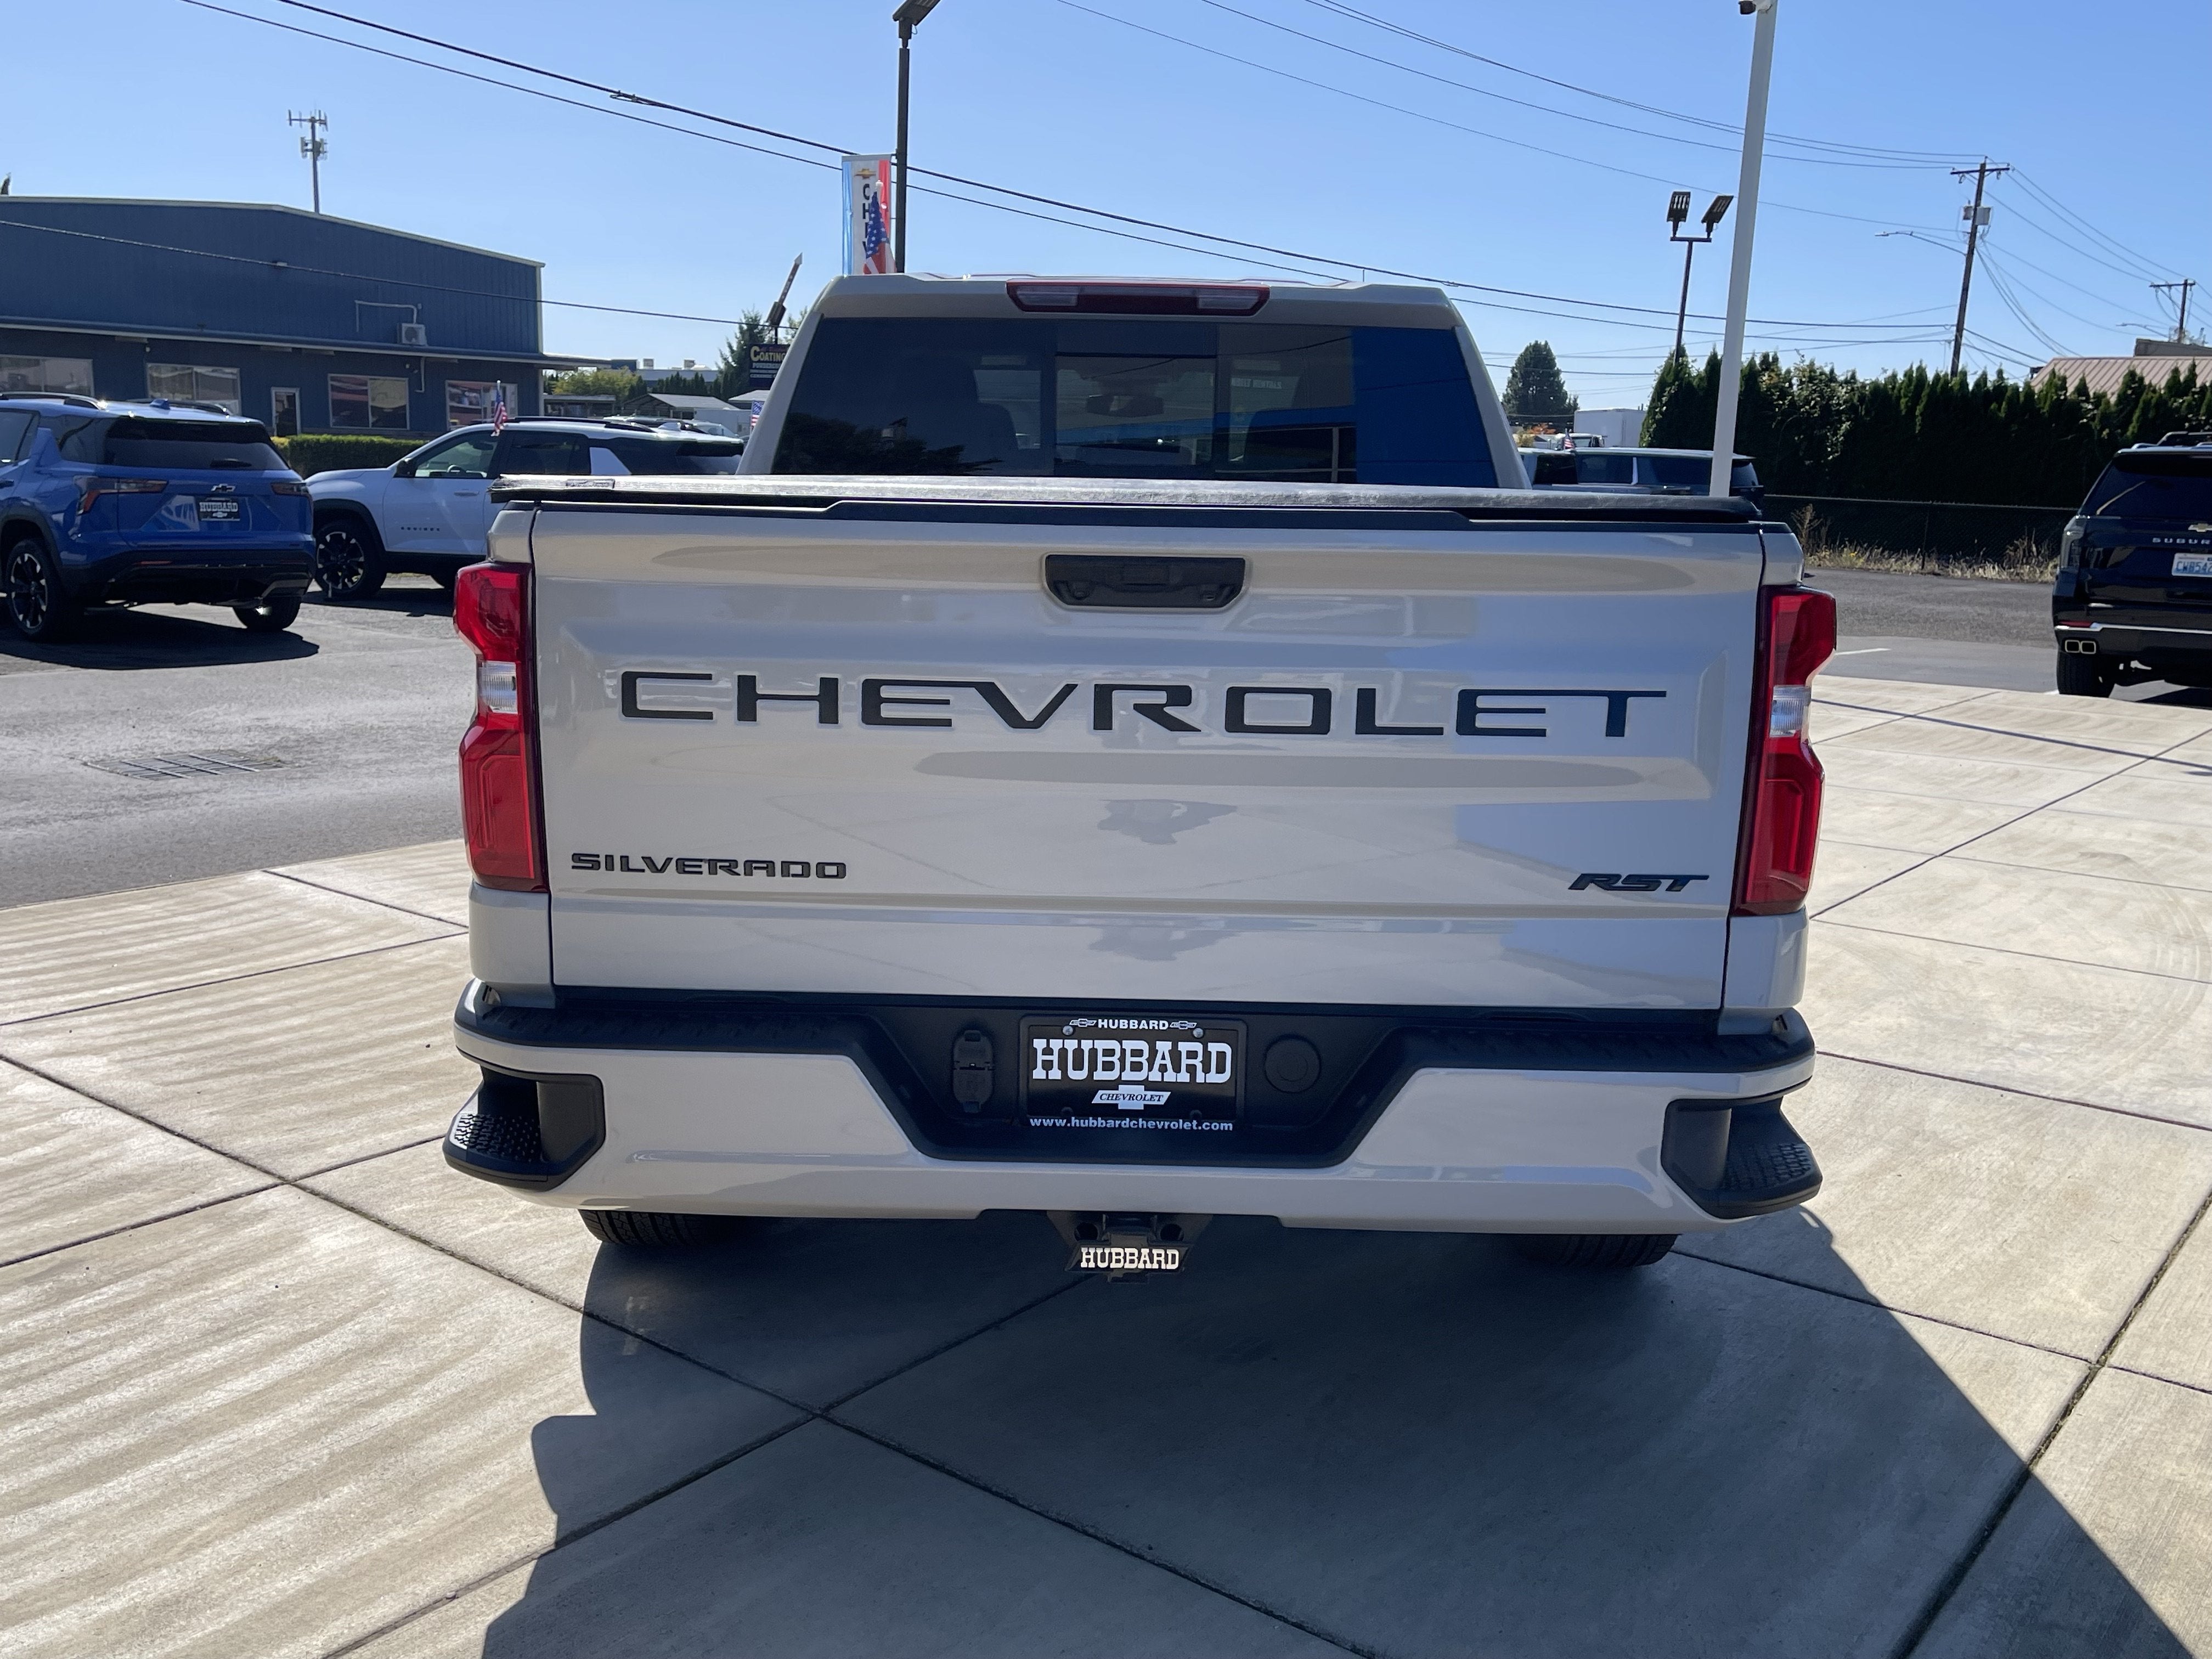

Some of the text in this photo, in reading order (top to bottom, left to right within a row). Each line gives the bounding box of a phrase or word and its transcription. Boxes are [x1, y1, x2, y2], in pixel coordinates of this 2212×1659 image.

[621, 671, 1667, 737] CHEVROLET
[571, 853, 847, 879] SILVERADO
[1568, 873, 1709, 891] RST
[1098, 1019, 1169, 1030] HUBBARD
[1032, 1039, 1232, 1084] HUBBARD
[1099, 1093, 1164, 1102] CHEVROLET
[1030, 1117, 1233, 1131] www.hubbardchevrolet.com
[1080, 1247, 1179, 1269] HUBBARD
